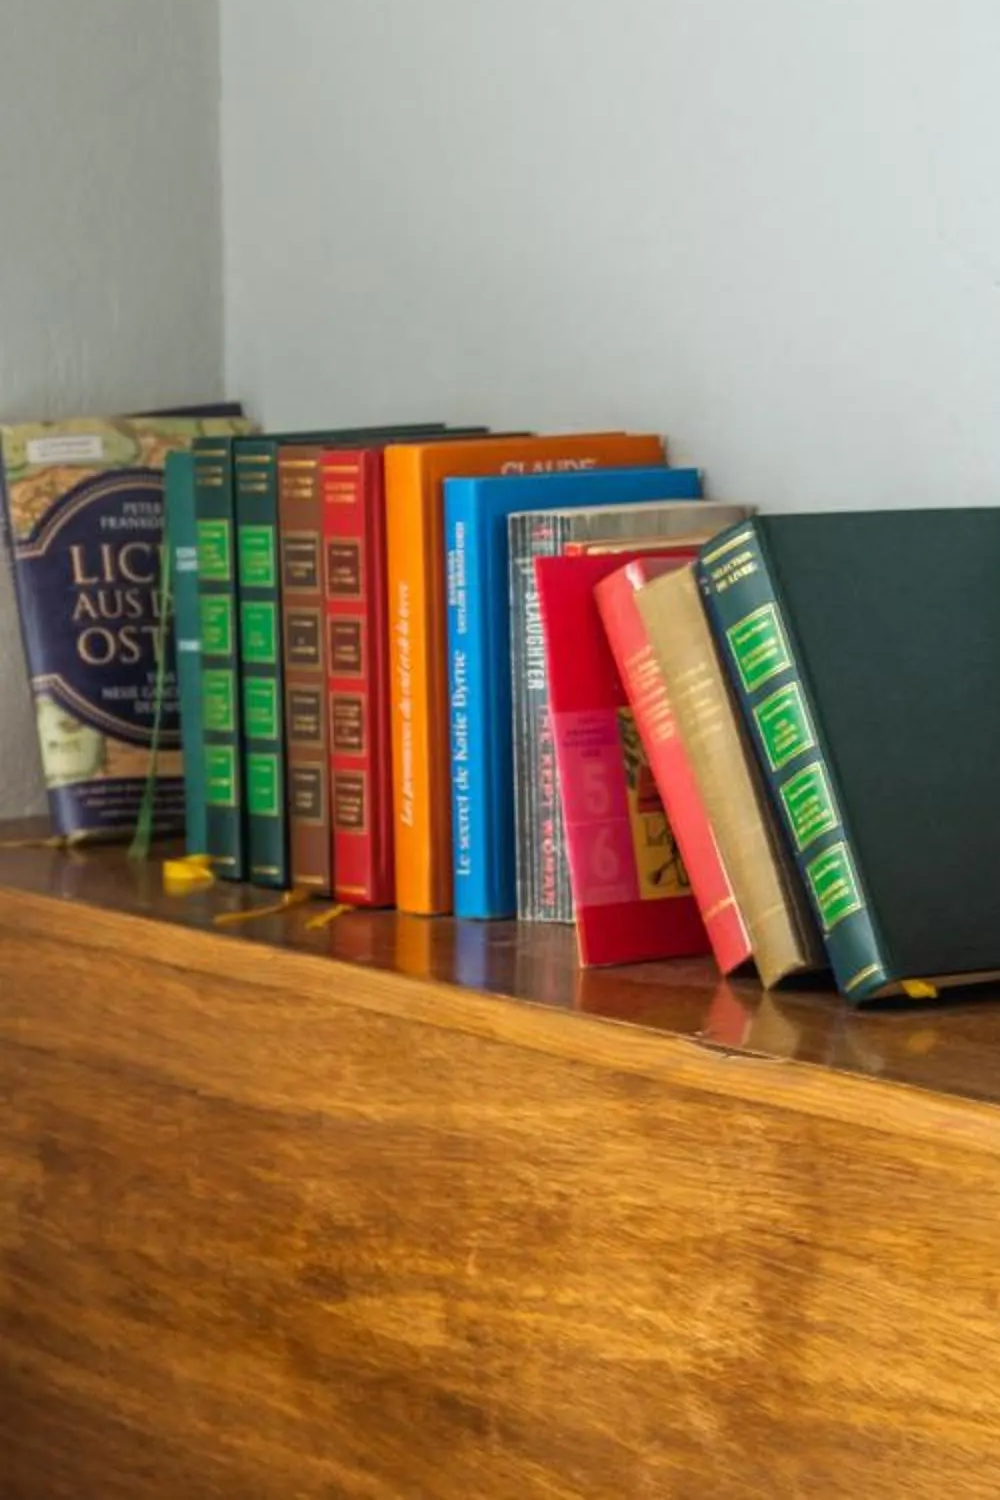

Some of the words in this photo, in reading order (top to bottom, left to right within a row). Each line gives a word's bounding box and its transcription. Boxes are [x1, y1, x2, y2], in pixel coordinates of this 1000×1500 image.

[100, 516, 165, 531] FRANKO
[69, 542, 169, 584] LIC
[72, 588, 143, 621] AUS
[77, 626, 171, 665] OST
[525, 591, 545, 690] SLAUGHTER
[451, 649, 469, 708] Byrne
[453, 711, 469, 762] Katie
[453, 767, 470, 791] de
[456, 795, 471, 850] secret
[456, 854, 471, 877] Le
[541, 819, 556, 906] WOMAN
